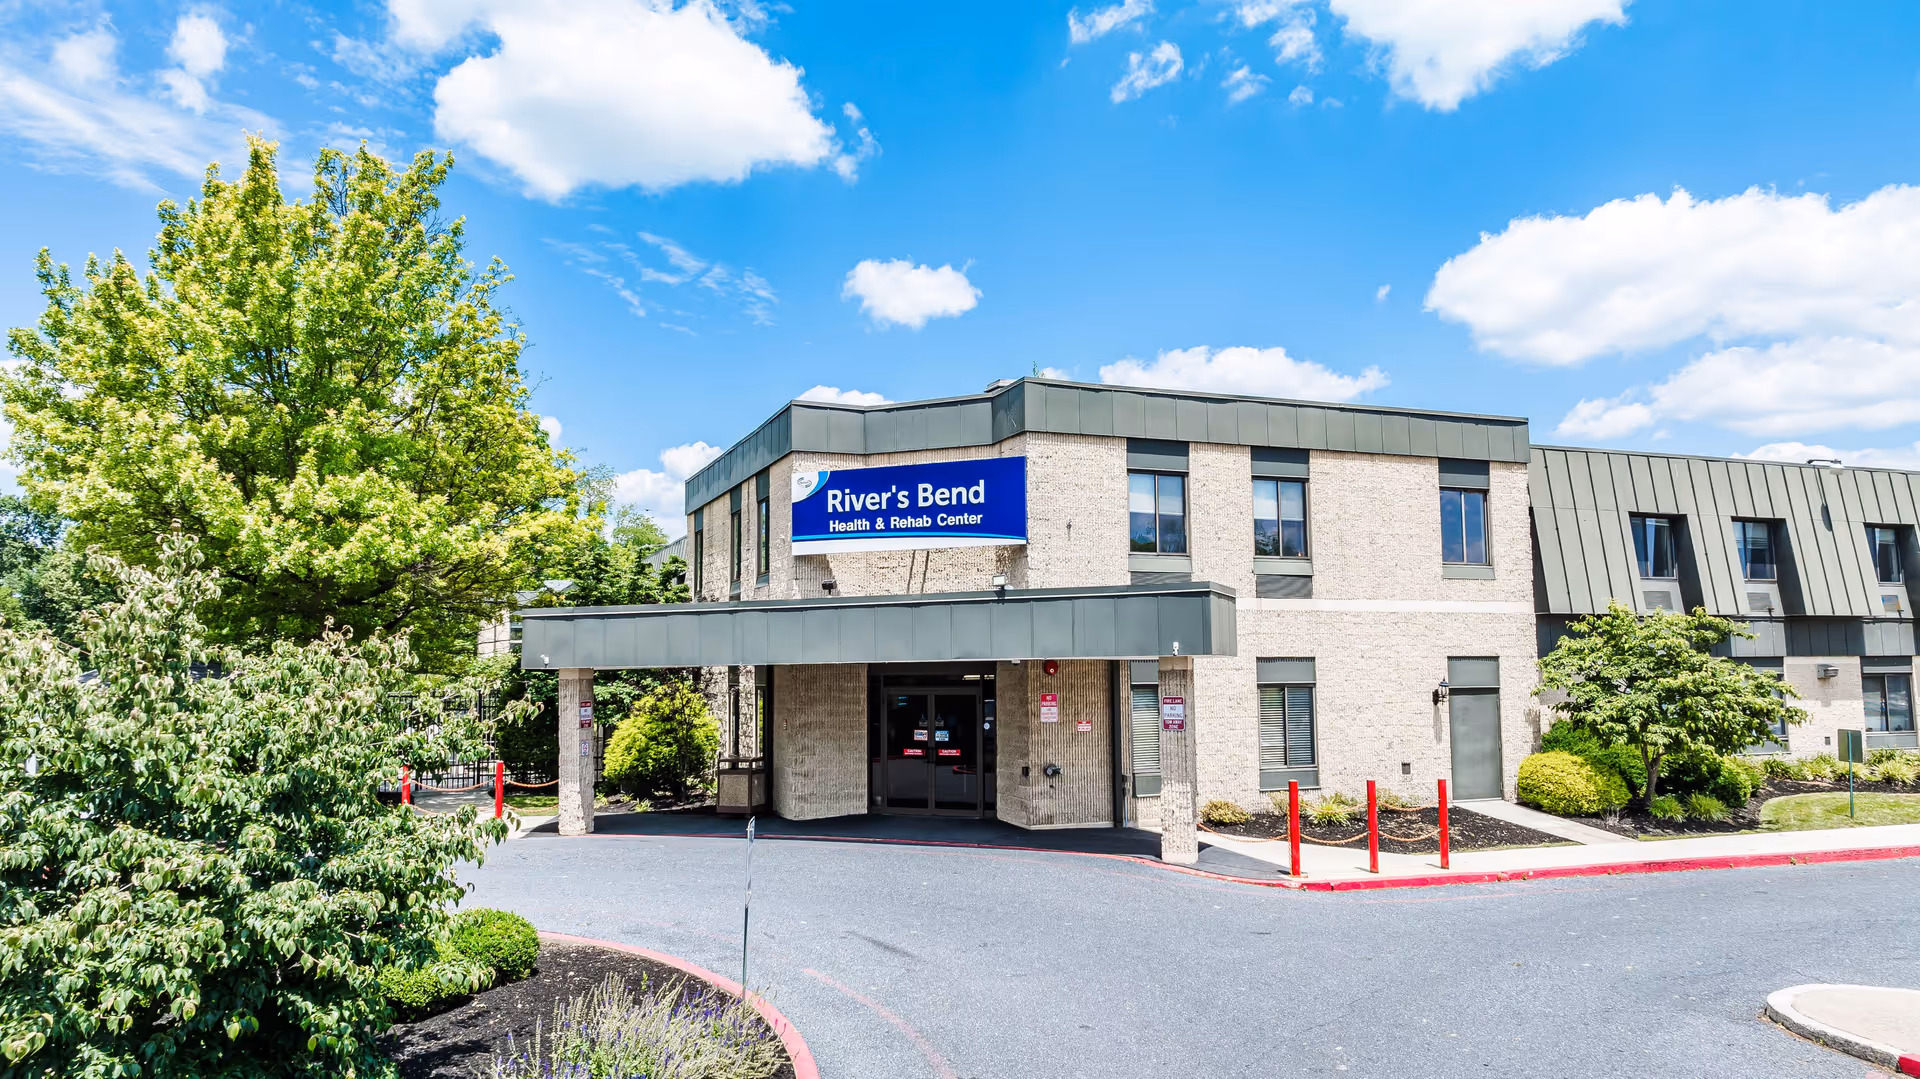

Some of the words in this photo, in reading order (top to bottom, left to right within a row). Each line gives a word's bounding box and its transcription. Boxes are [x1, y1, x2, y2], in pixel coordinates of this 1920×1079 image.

[827, 485, 910, 513] River's
[917, 479, 985, 508] Bend
[829, 518, 870, 532] Health
[875, 518, 885, 530] &
[890, 515, 932, 529] Rehab
[936, 513, 983, 527] Center
